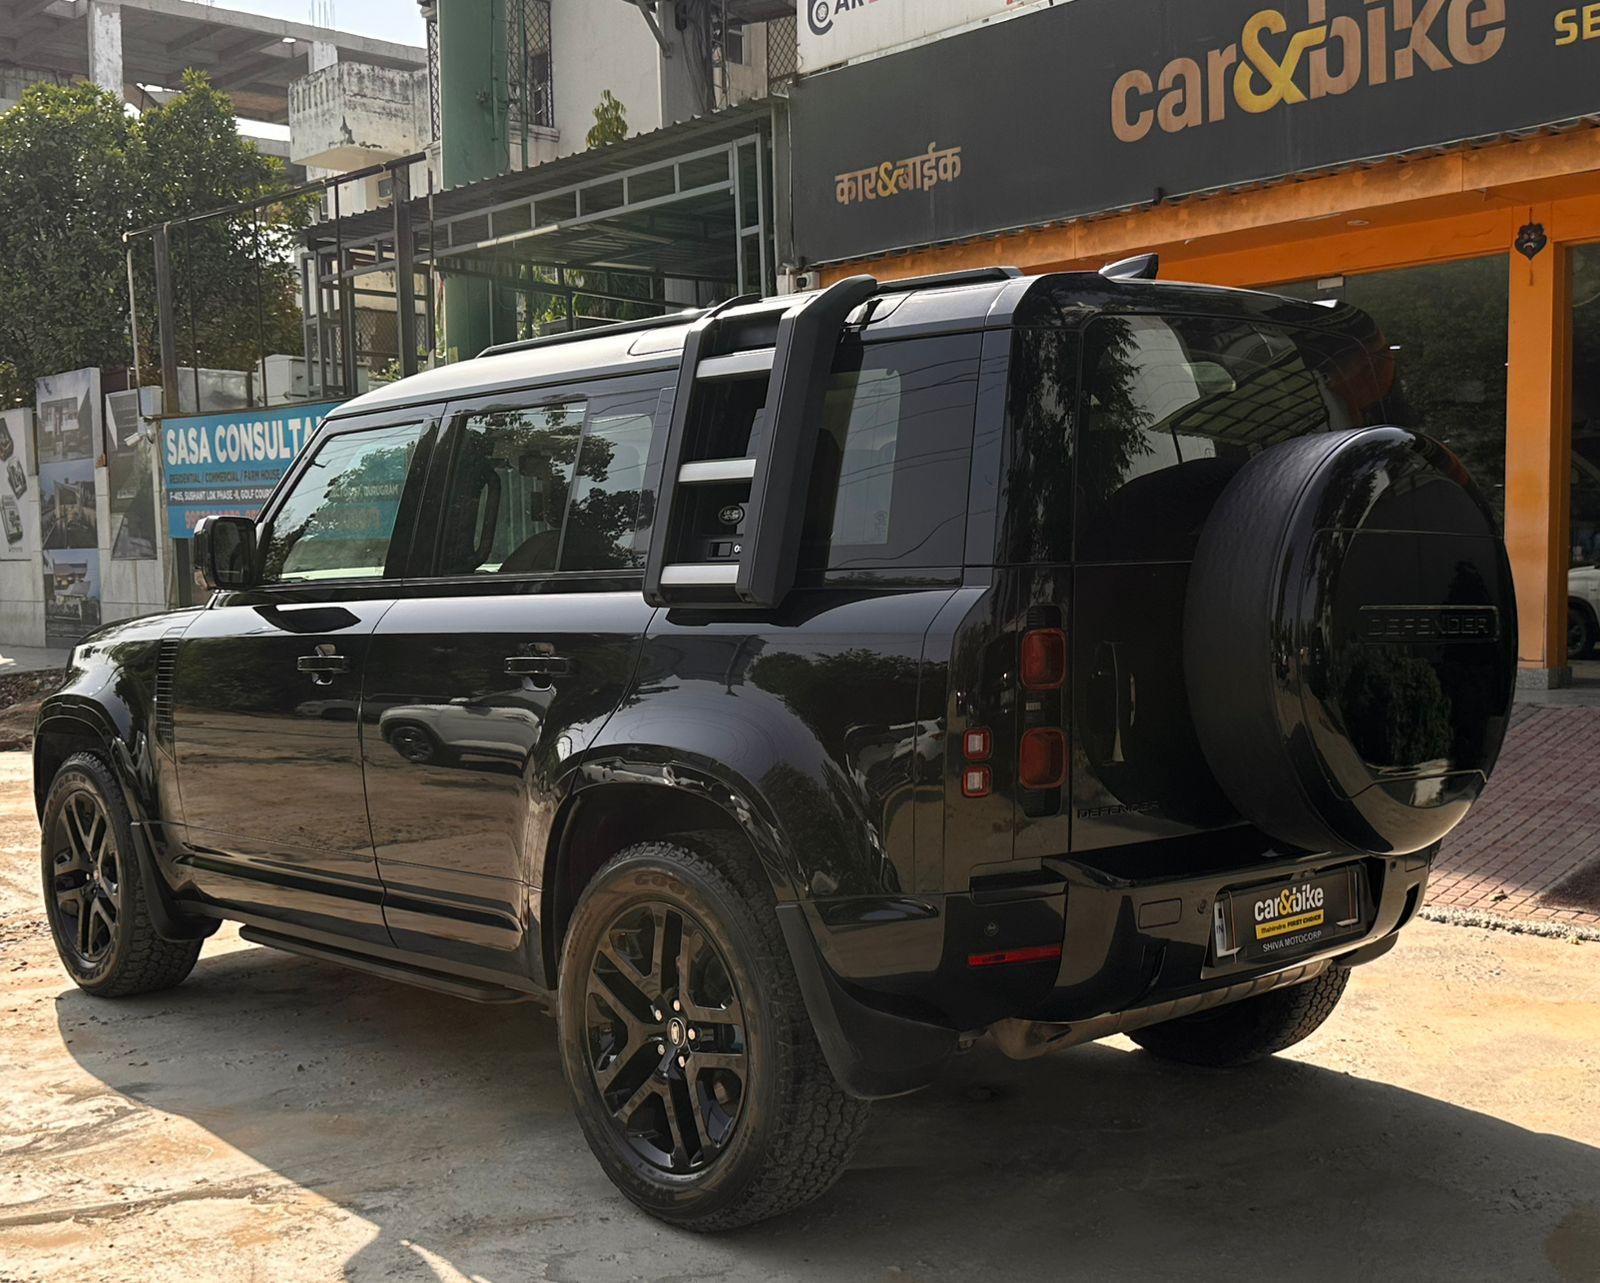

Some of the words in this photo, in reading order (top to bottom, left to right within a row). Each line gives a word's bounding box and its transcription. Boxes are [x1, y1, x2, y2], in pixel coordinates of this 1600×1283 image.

[1110, 0, 1506, 142] car&bike
[1554, 3, 1600, 46] SE
[834, 141, 962, 205] कार&बाईक
[166, 426, 212, 466] SASA
[214, 415, 322, 464] CONSULTA
[240, 489, 255, 499] GOLF
[1366, 617, 1489, 635] DEFENDER
[1254, 884, 1324, 921] car&bike
[1262, 940, 1284, 952] SHIVA
[1284, 930, 1322, 947] MOTOCORP
